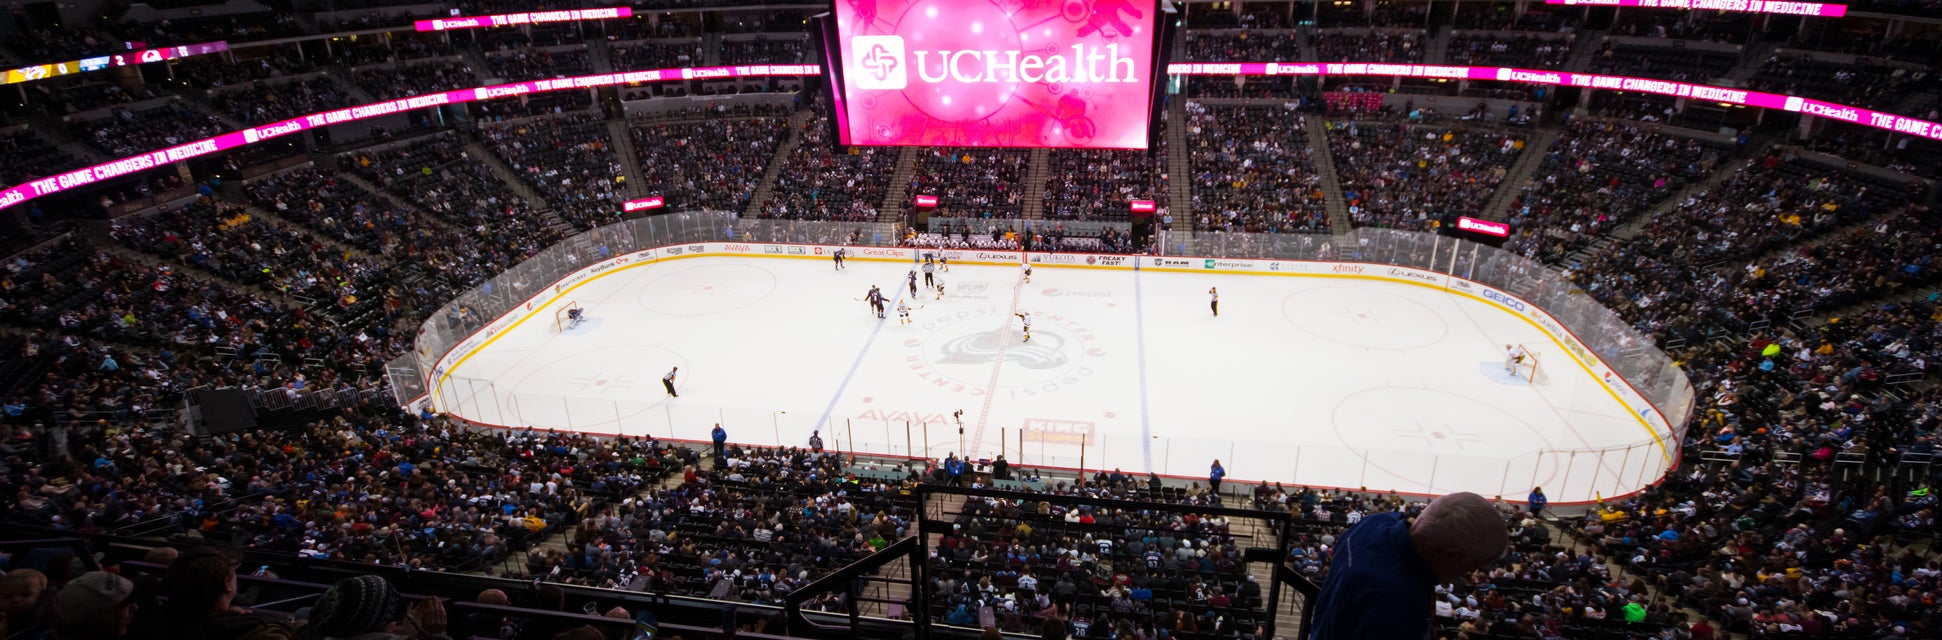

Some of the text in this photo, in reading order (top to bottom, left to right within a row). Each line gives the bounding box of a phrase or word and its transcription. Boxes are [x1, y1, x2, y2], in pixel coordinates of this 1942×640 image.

[1692, 0, 1749, 11] CHANGERS
[1749, 2, 1763, 12] IN
[1763, 2, 1823, 16] MEDICINE
[443, 18, 479, 28] UCHealth
[491, 8, 618, 25] THE GAME CHANGERS IN MEDICINE
[114, 54, 126, 66] 2
[913, 42, 1139, 84] UCHealth
[693, 68, 730, 78] UCHealth
[735, 66, 750, 76] THE
[751, 66, 770, 76] GAME
[770, 65, 804, 76] CHANGERS
[804, 64, 812, 74] IN
[1192, 64, 1202, 74] IN
[1202, 64, 1241, 74] MEDICINE
[1278, 64, 1319, 74] UCHealth
[1326, 64, 1470, 78] THE GAME CHANGERS IN MEDICINE
[534, 70, 661, 92] THE GAME CHANGERS IN MEDICINE
[1512, 72, 1560, 84] UCHealth
[487, 84, 529, 97] UCHealth
[1570, 74, 1748, 104] THE GAME CHANGERS IN MEDICINE
[306, 92, 448, 128] THE GAME CHANGERS IN MEDICINE
[1802, 102, 1859, 122] UCHealth
[1870, 112, 1895, 128] THE
[1894, 118, 1931, 136] GAME
[256, 122, 302, 140] UCHealth
[30, 140, 218, 196] THE GAME CHANGERS IN MEDICINE
[724, 244, 750, 252] AVAYA
[864, 248, 904, 258] Great Clips
[590, 262, 616, 274] KeyBank
[1208, 261, 1253, 269] enterprise
[1332, 264, 1364, 274] xfinity
[1401, 271, 1437, 282] LEXUS
[1482, 288, 1525, 312] GEICO
[857, 408, 948, 426] AVAYA
